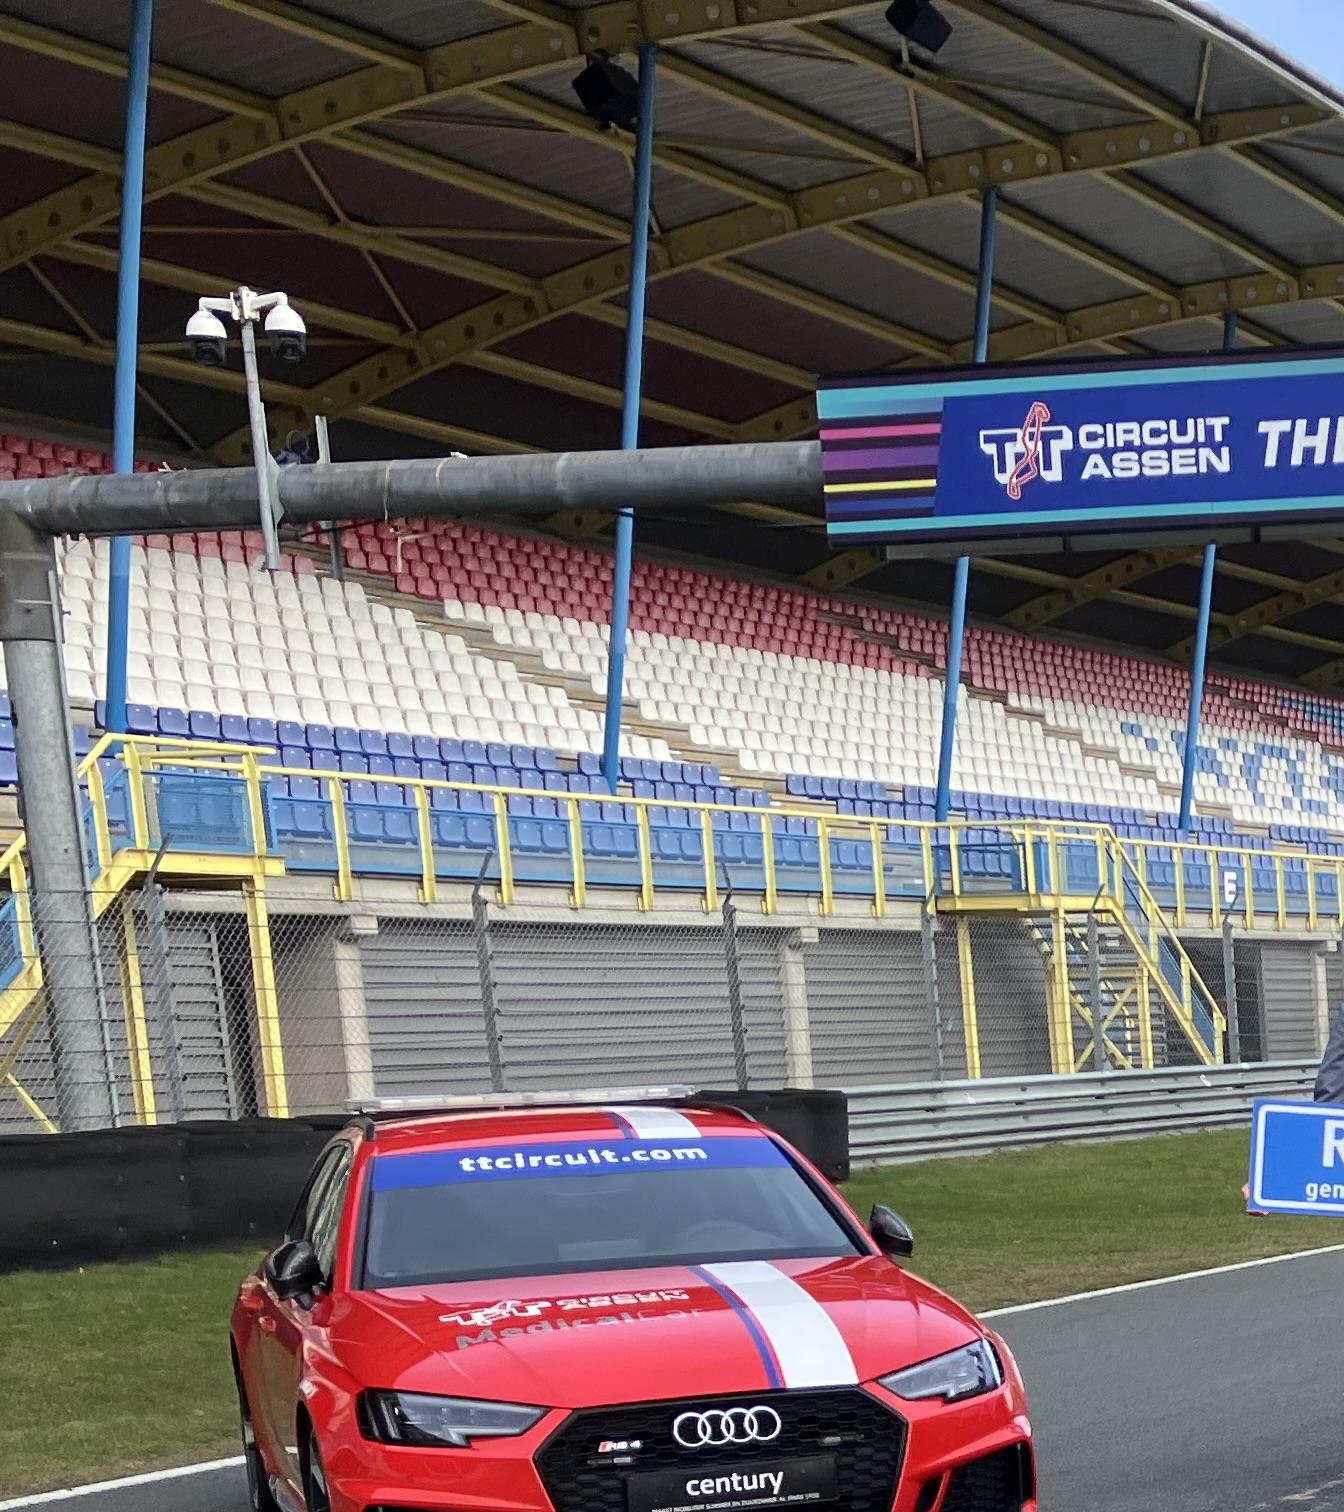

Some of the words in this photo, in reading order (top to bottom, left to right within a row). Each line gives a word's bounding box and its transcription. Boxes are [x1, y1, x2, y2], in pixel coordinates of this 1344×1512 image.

[1078, 417, 1231, 449] CIRCUIT
[1080, 446, 1231, 480] ASSEN
[1223, 870, 1238, 903] E
[459, 1147, 708, 1172] ttcircuit.com
[686, 1471, 784, 1496] century
